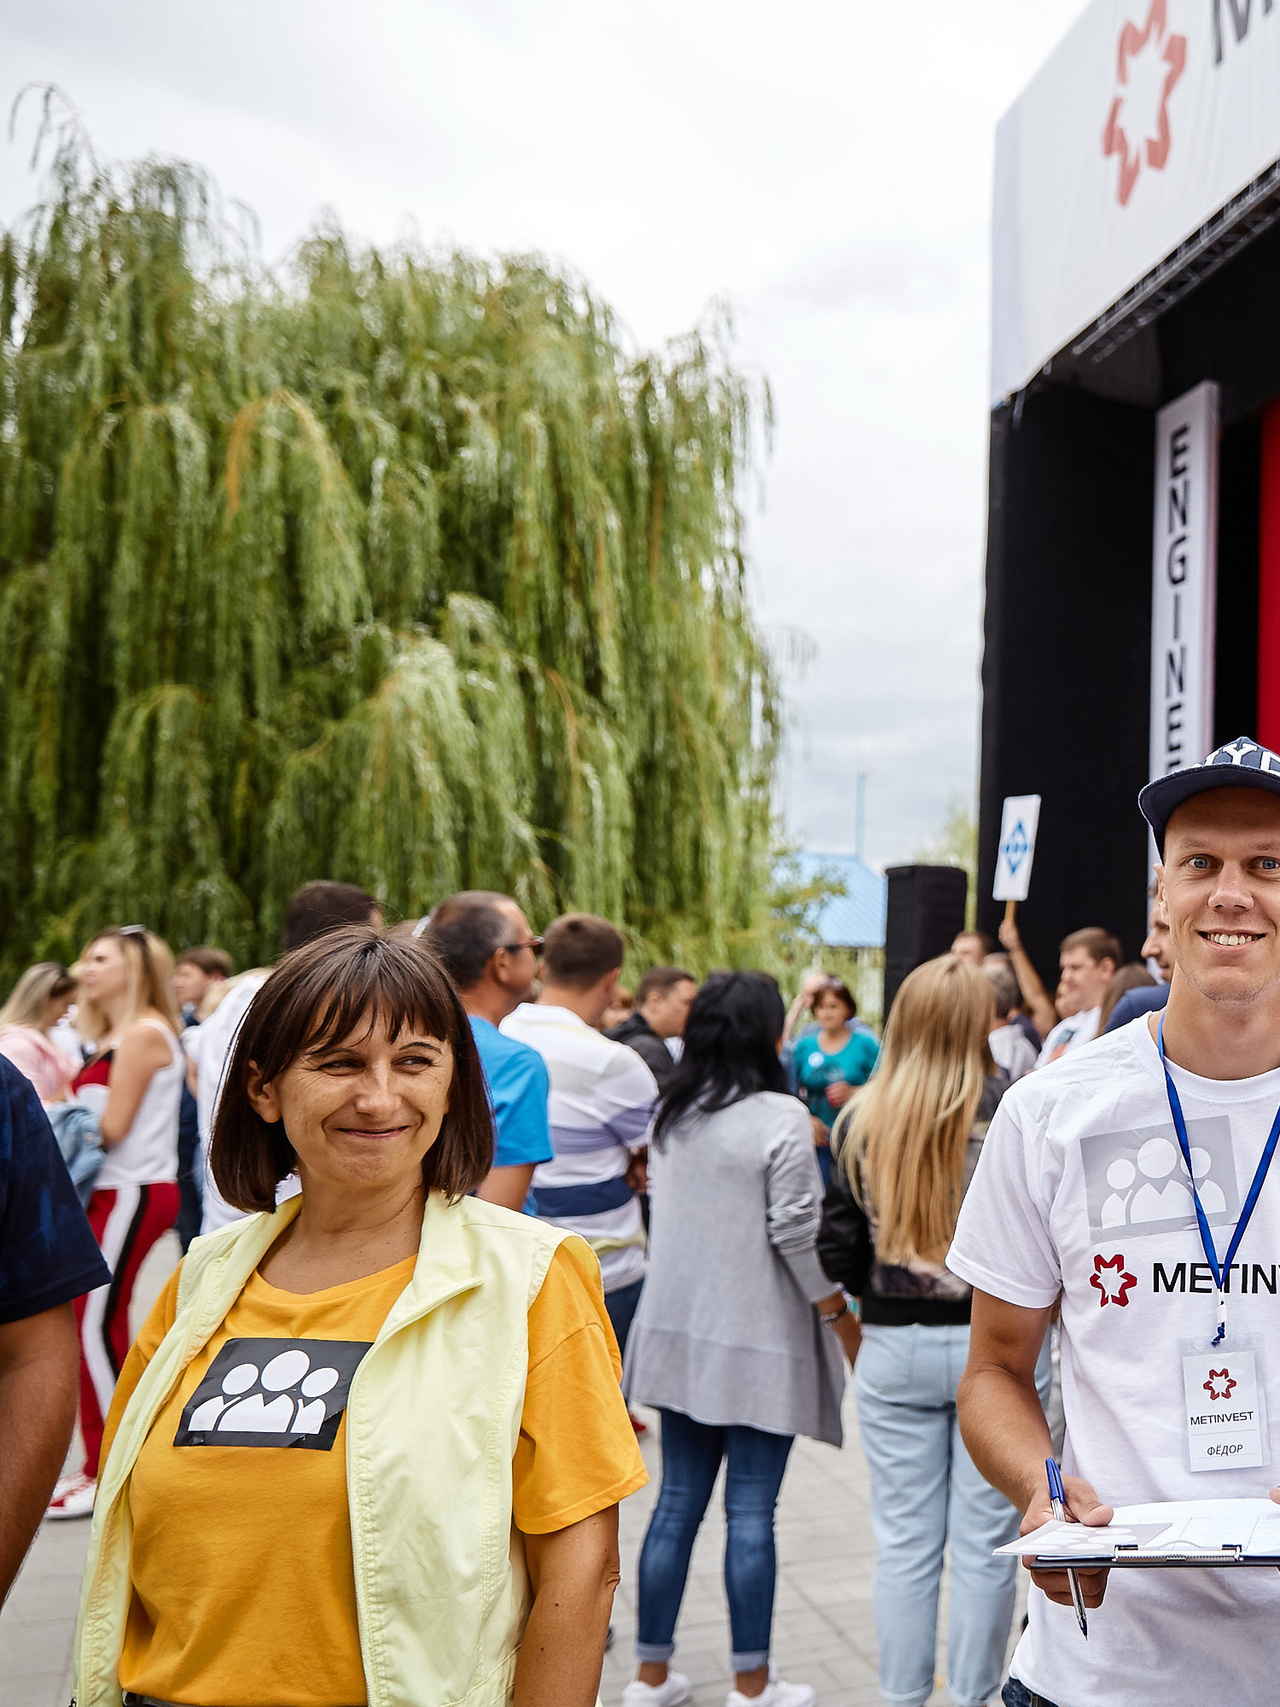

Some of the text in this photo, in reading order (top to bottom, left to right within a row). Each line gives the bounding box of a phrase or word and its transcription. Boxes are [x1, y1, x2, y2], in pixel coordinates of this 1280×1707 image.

[1165, 422, 1190, 774] ENGINE
[1190, 1411, 1254, 1426] METINVEST
[1206, 1444, 1244, 1457] ФЁДОР
